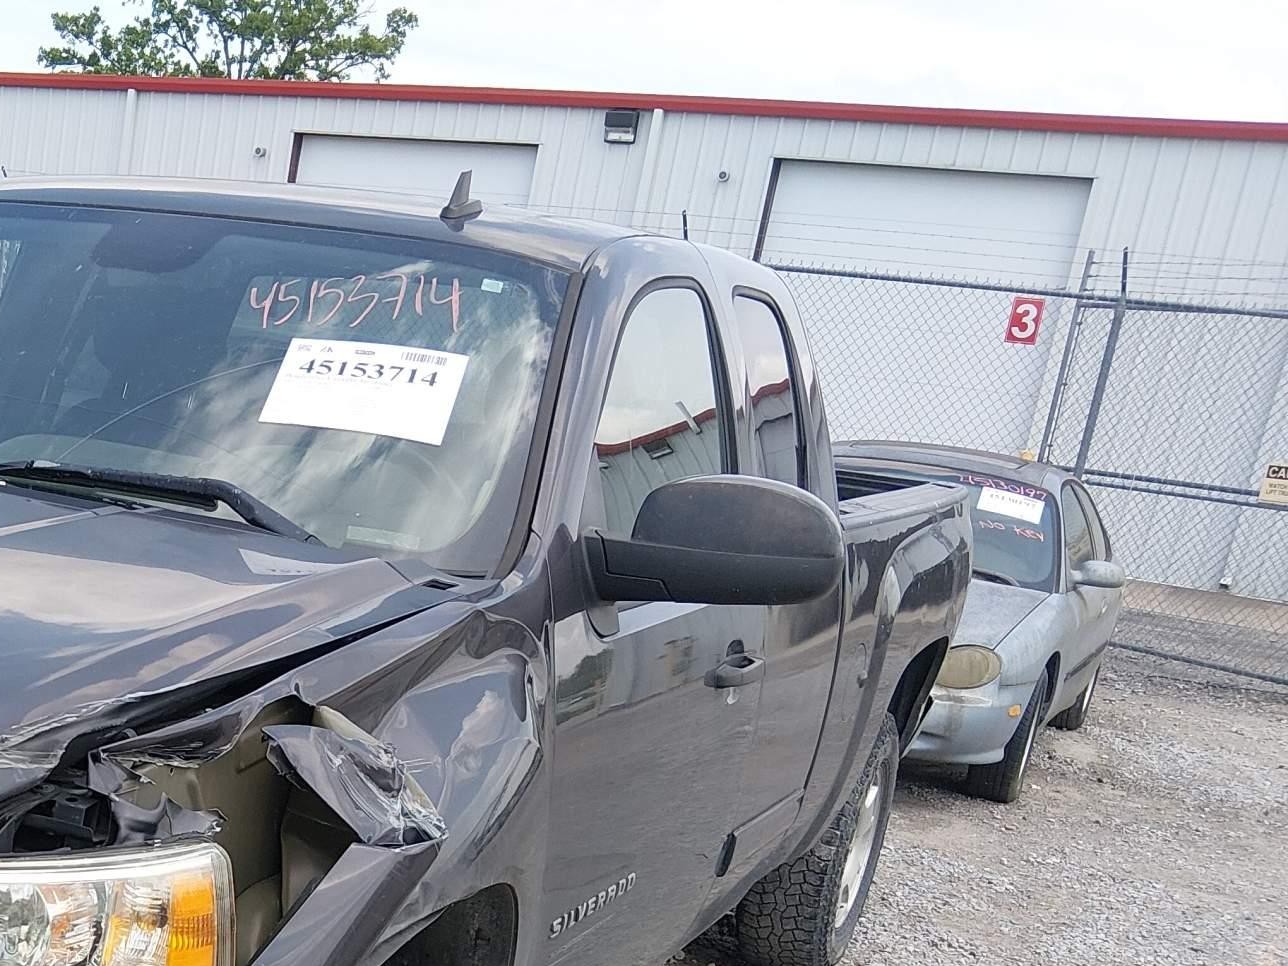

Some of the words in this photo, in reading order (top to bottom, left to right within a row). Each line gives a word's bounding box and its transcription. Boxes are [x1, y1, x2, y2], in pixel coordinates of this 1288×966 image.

[250, 273, 463, 334] 45153714
[1011, 303, 1038, 339] 3
[299, 359, 439, 387] 45153714
[1269, 467, 1288, 478] CA
[549, 872, 636, 939] SILVERADO
